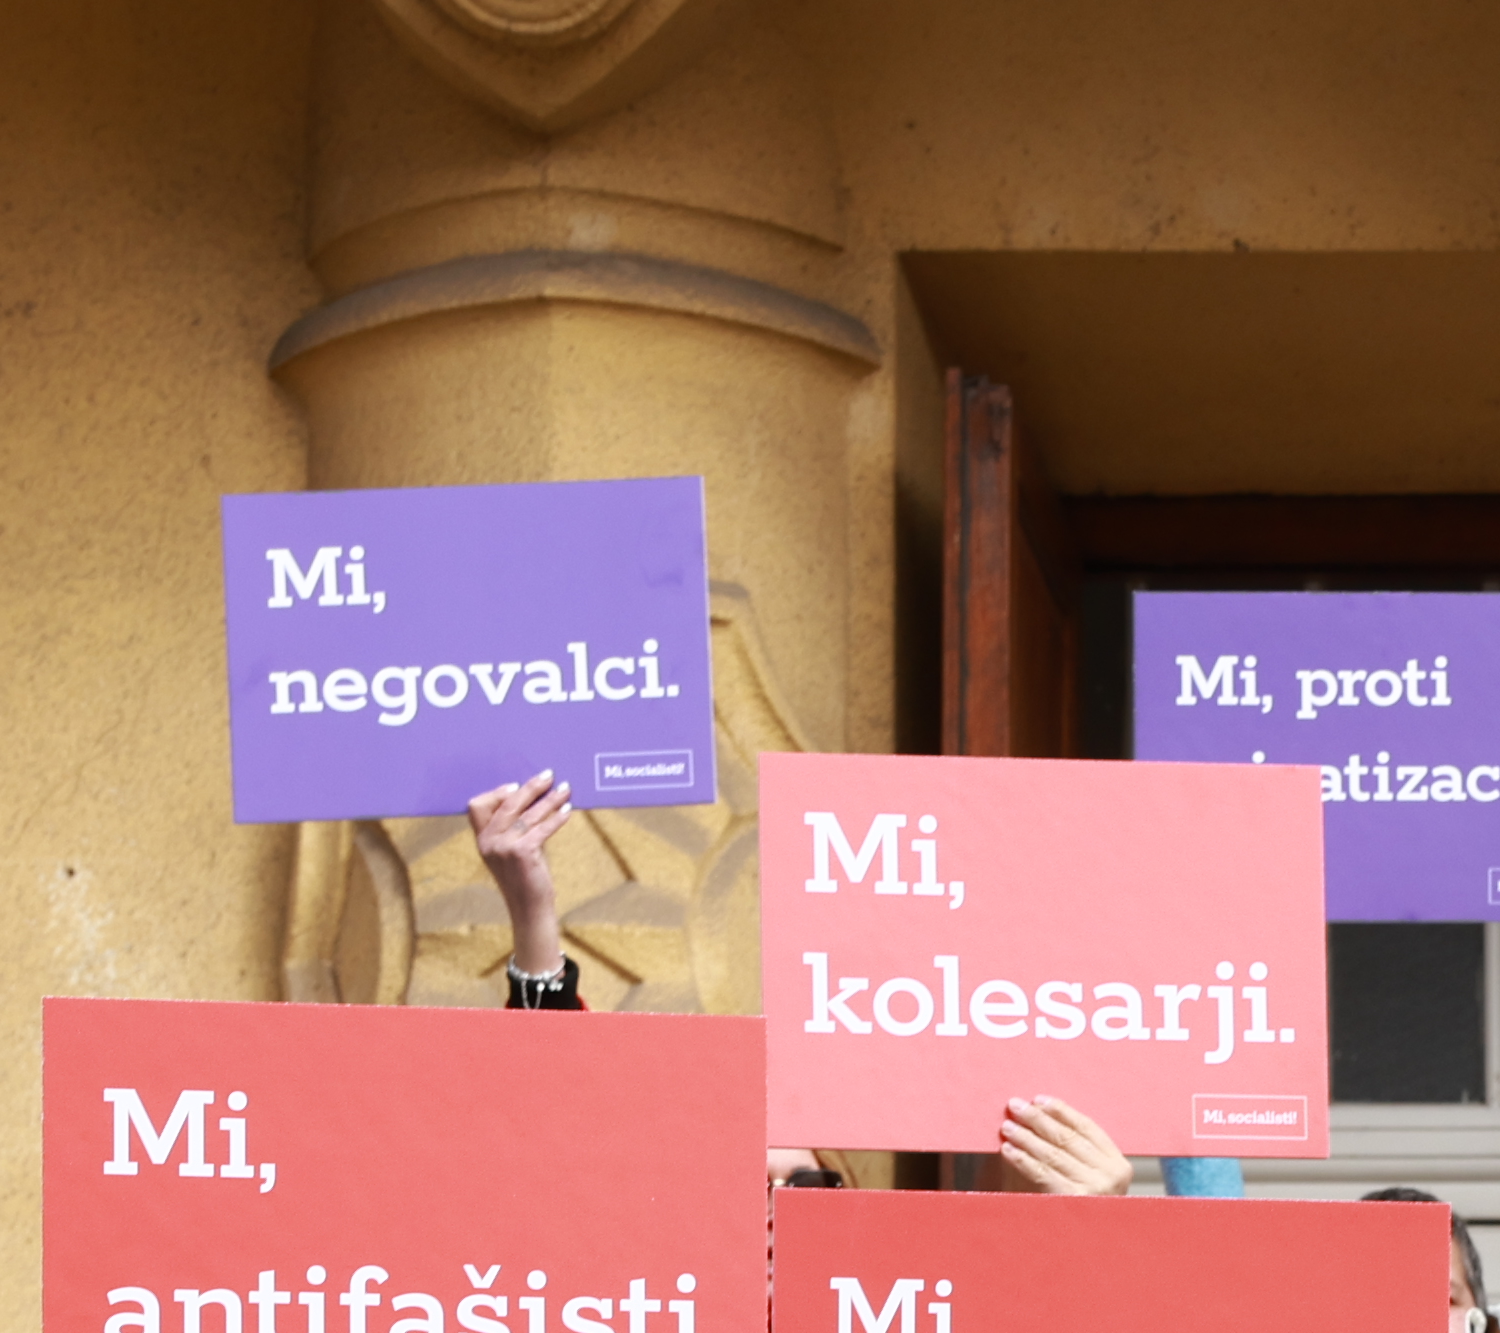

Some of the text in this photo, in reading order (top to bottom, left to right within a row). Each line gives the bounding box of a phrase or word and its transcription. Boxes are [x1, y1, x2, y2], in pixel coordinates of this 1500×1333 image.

[266, 546, 385, 613] Mi,
[269, 639, 679, 726] negovalci.
[1176, 656, 1451, 719] Mi, proti
[604, 763, 686, 779] Mi, socialisti!
[804, 812, 964, 909] Mi,
[803, 952, 1295, 1063] kolesarji.
[104, 1088, 275, 1193] Mi,
[1203, 1109, 1298, 1126] Mi, socialisti!
